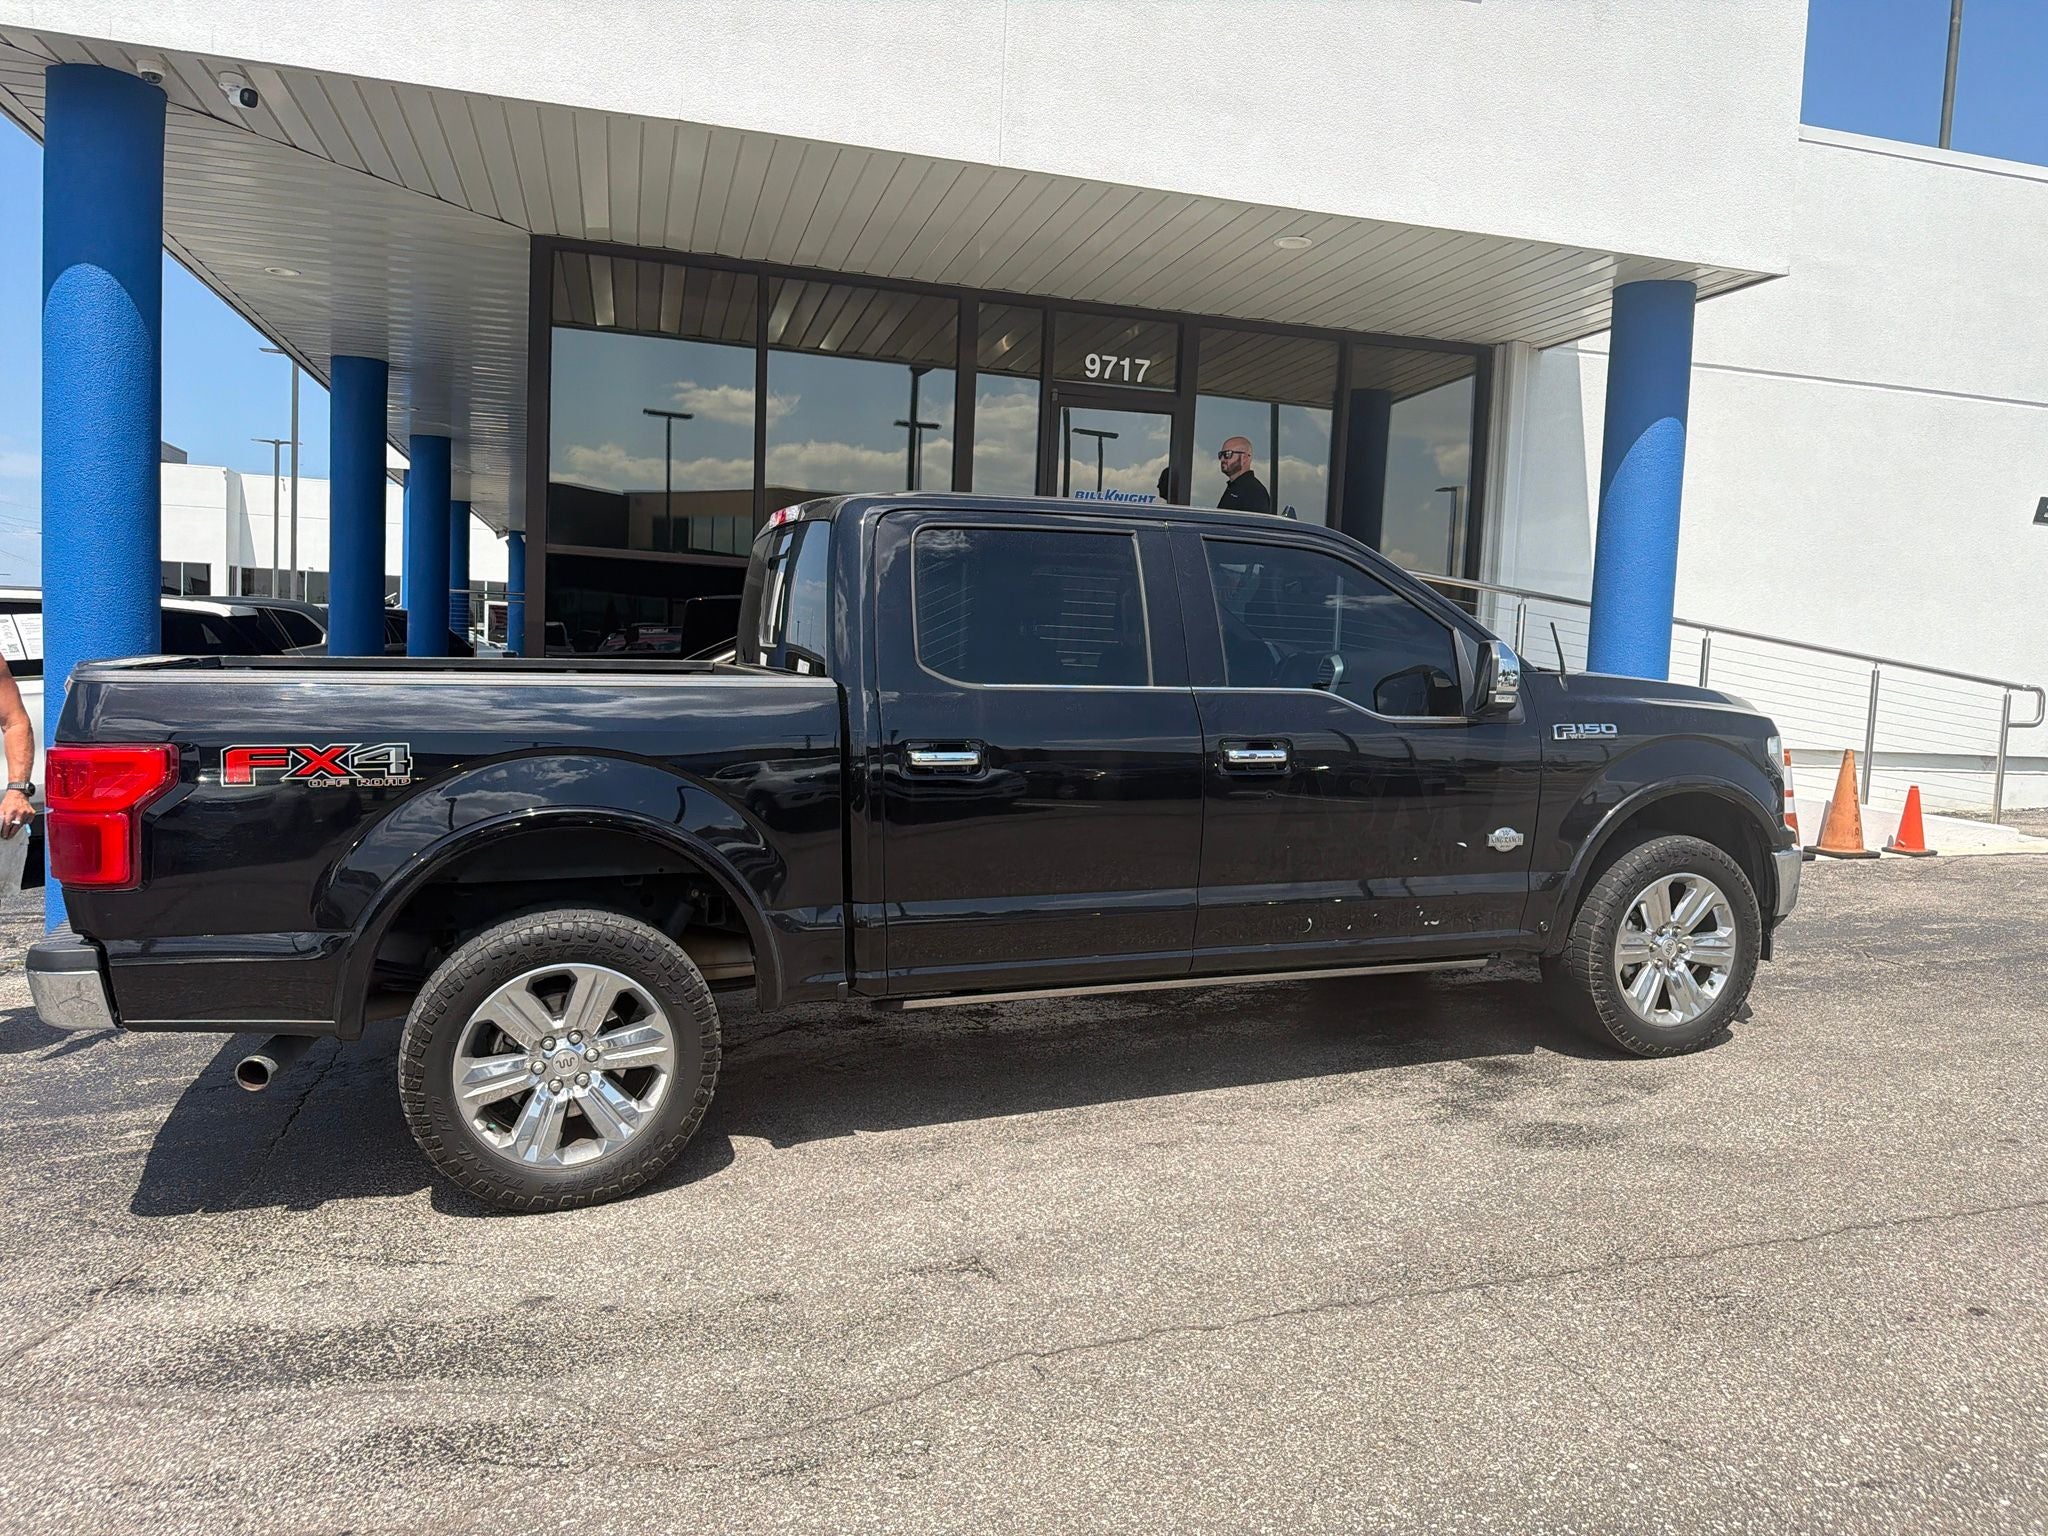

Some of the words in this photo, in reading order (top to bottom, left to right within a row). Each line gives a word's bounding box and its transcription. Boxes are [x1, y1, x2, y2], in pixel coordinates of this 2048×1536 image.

[1085, 353, 1151, 383] 9717
[221, 743, 413, 787] FX4
[308, 778, 350, 787] OFF
[357, 777, 411, 787] ROAD
[1491, 835, 1504, 844] KING
[1504, 835, 1522, 843] RANCH
